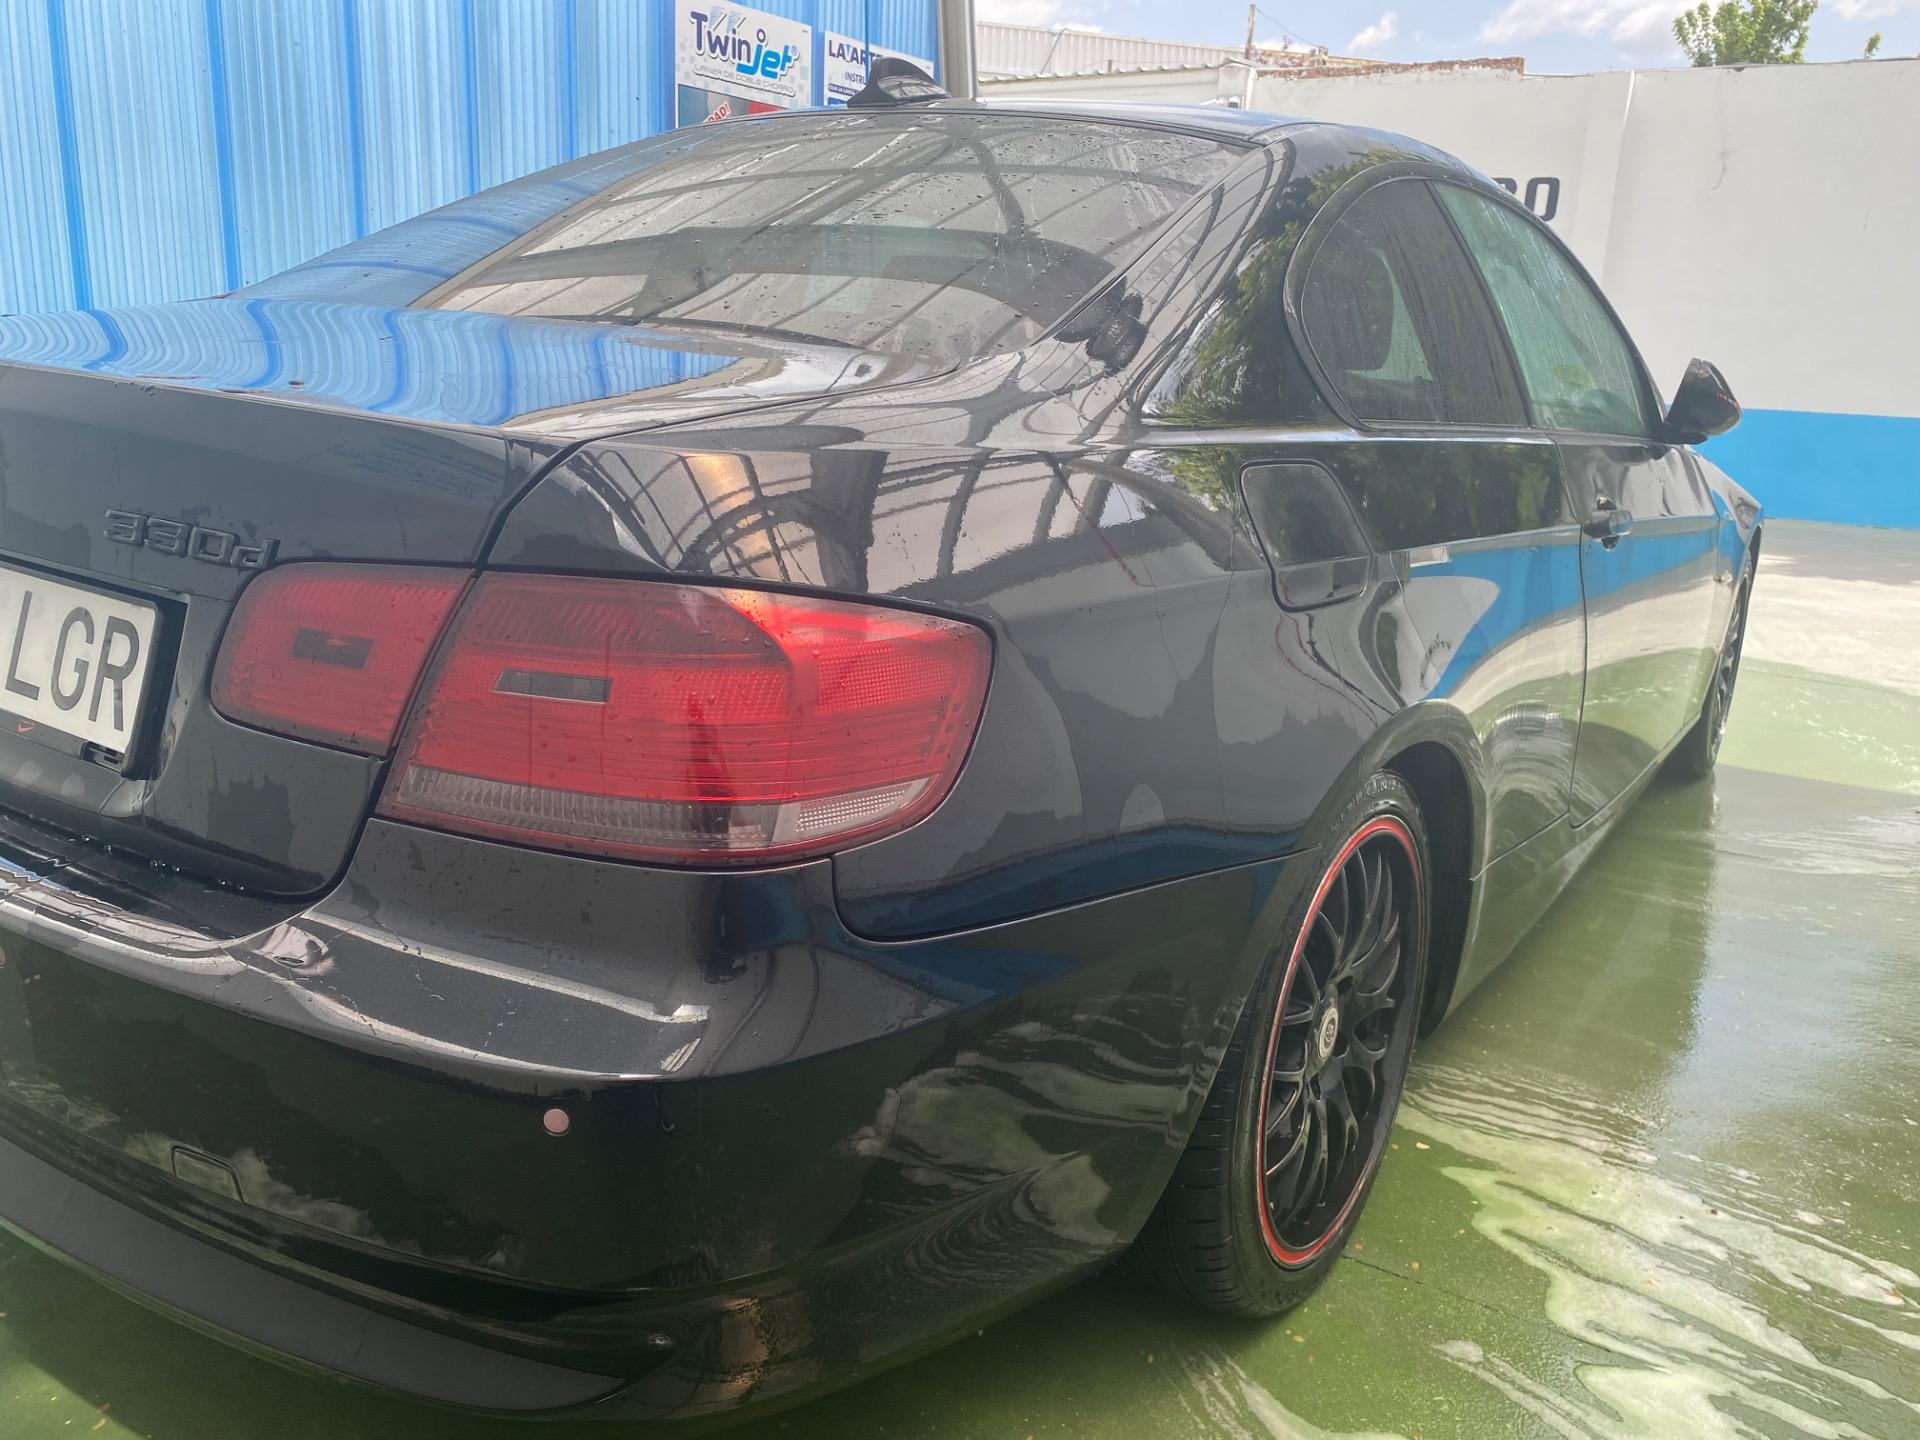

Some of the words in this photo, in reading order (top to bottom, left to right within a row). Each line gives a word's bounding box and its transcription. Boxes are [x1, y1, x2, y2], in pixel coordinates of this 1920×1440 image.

[695, 64, 723, 77] LANZA
[723, 71, 735, 80] DE
[736, 74, 762, 87] DOBLE
[762, 81, 794, 94] CHORRO
[104, 509, 281, 569] 330d
[5, 590, 140, 732] LGR
